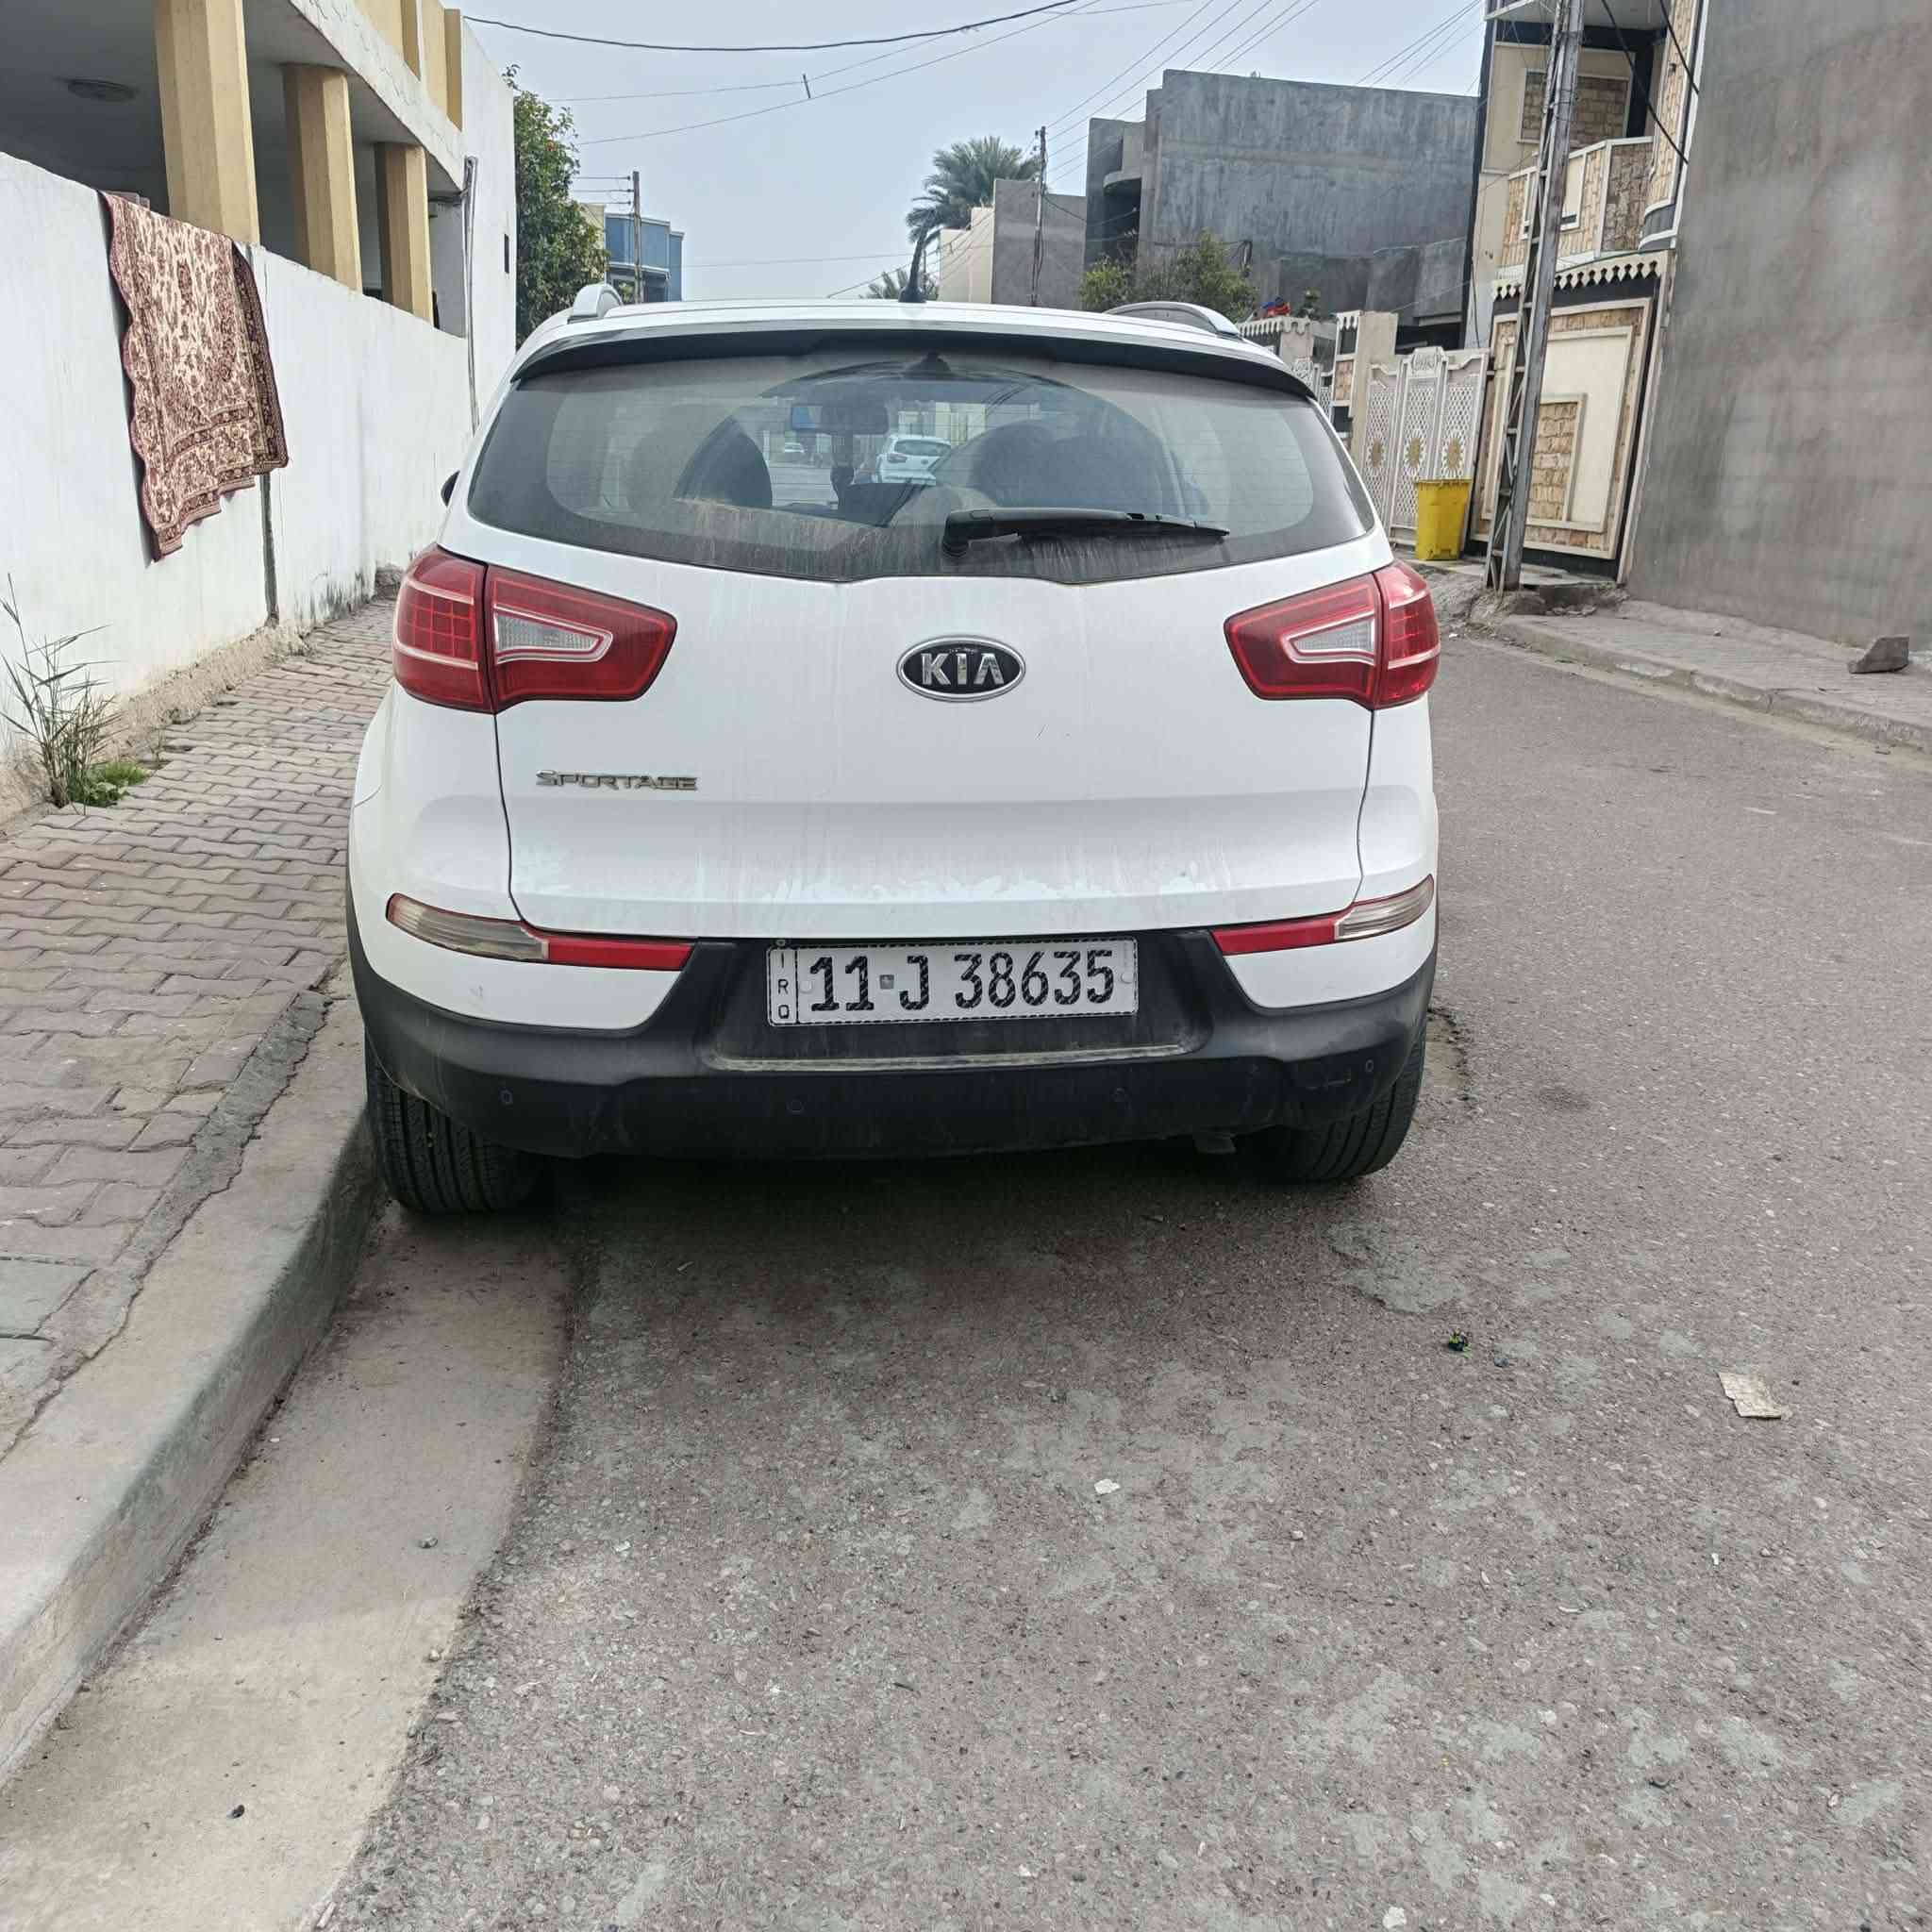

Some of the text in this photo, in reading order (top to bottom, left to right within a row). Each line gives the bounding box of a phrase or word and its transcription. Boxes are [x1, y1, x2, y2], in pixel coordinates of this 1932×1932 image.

[921, 653, 1005, 686] KIA
[536, 770, 698, 791] SPORTAGE
[953, 949, 1114, 1008] 38635
